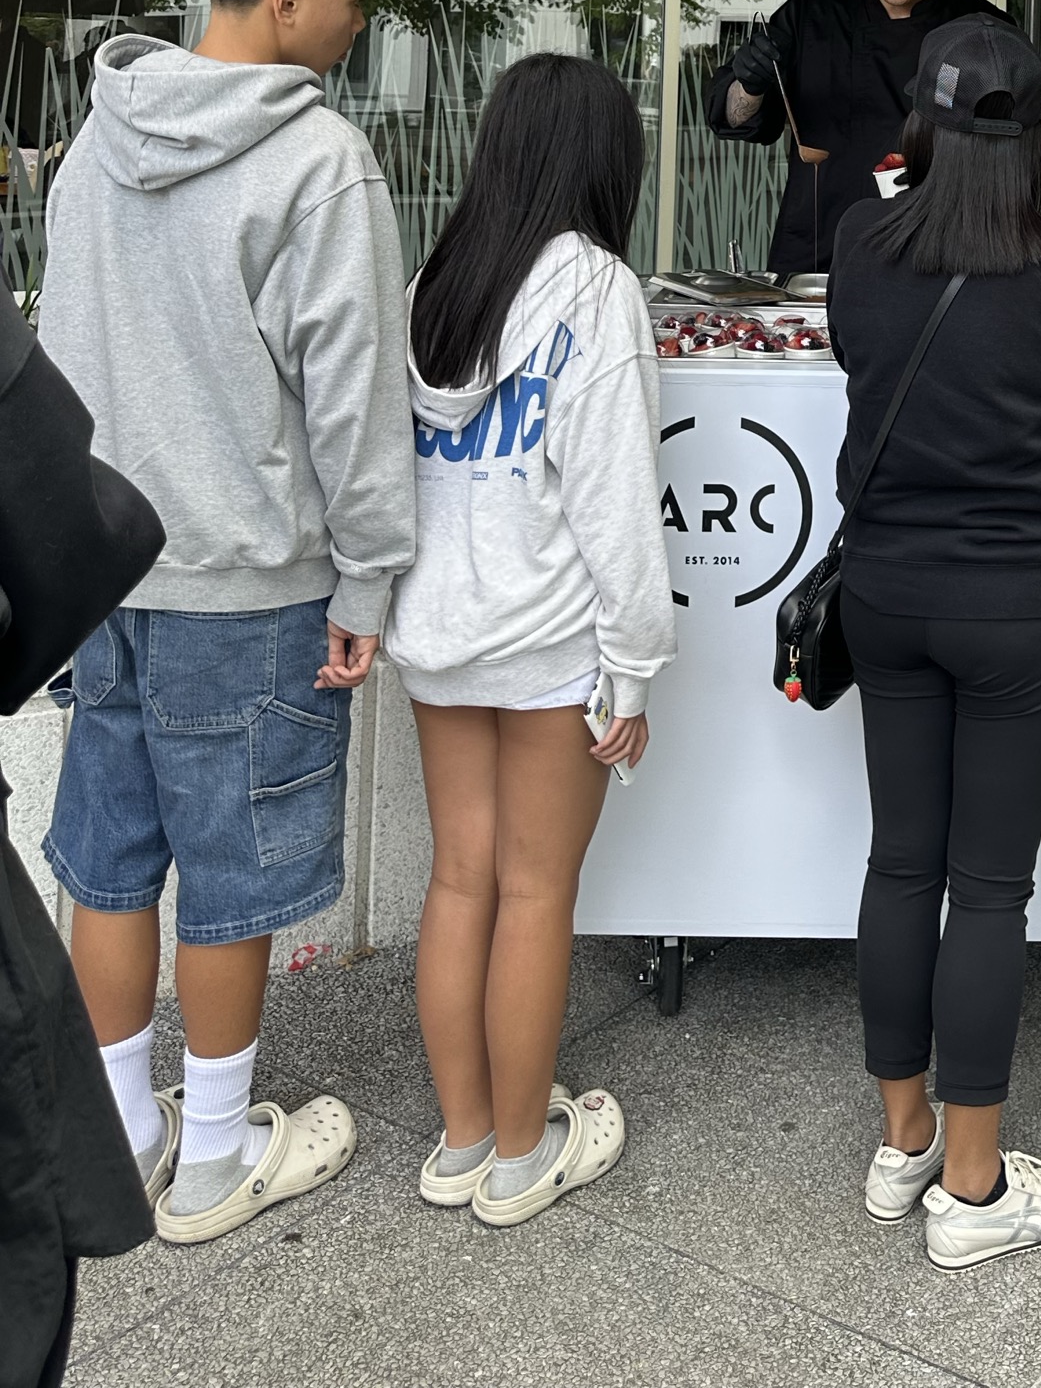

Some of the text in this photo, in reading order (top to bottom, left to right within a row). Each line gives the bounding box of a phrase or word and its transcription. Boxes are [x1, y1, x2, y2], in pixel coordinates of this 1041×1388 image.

[660, 483, 775, 534] ARC
[685, 556, 740, 565] EST. 2014
